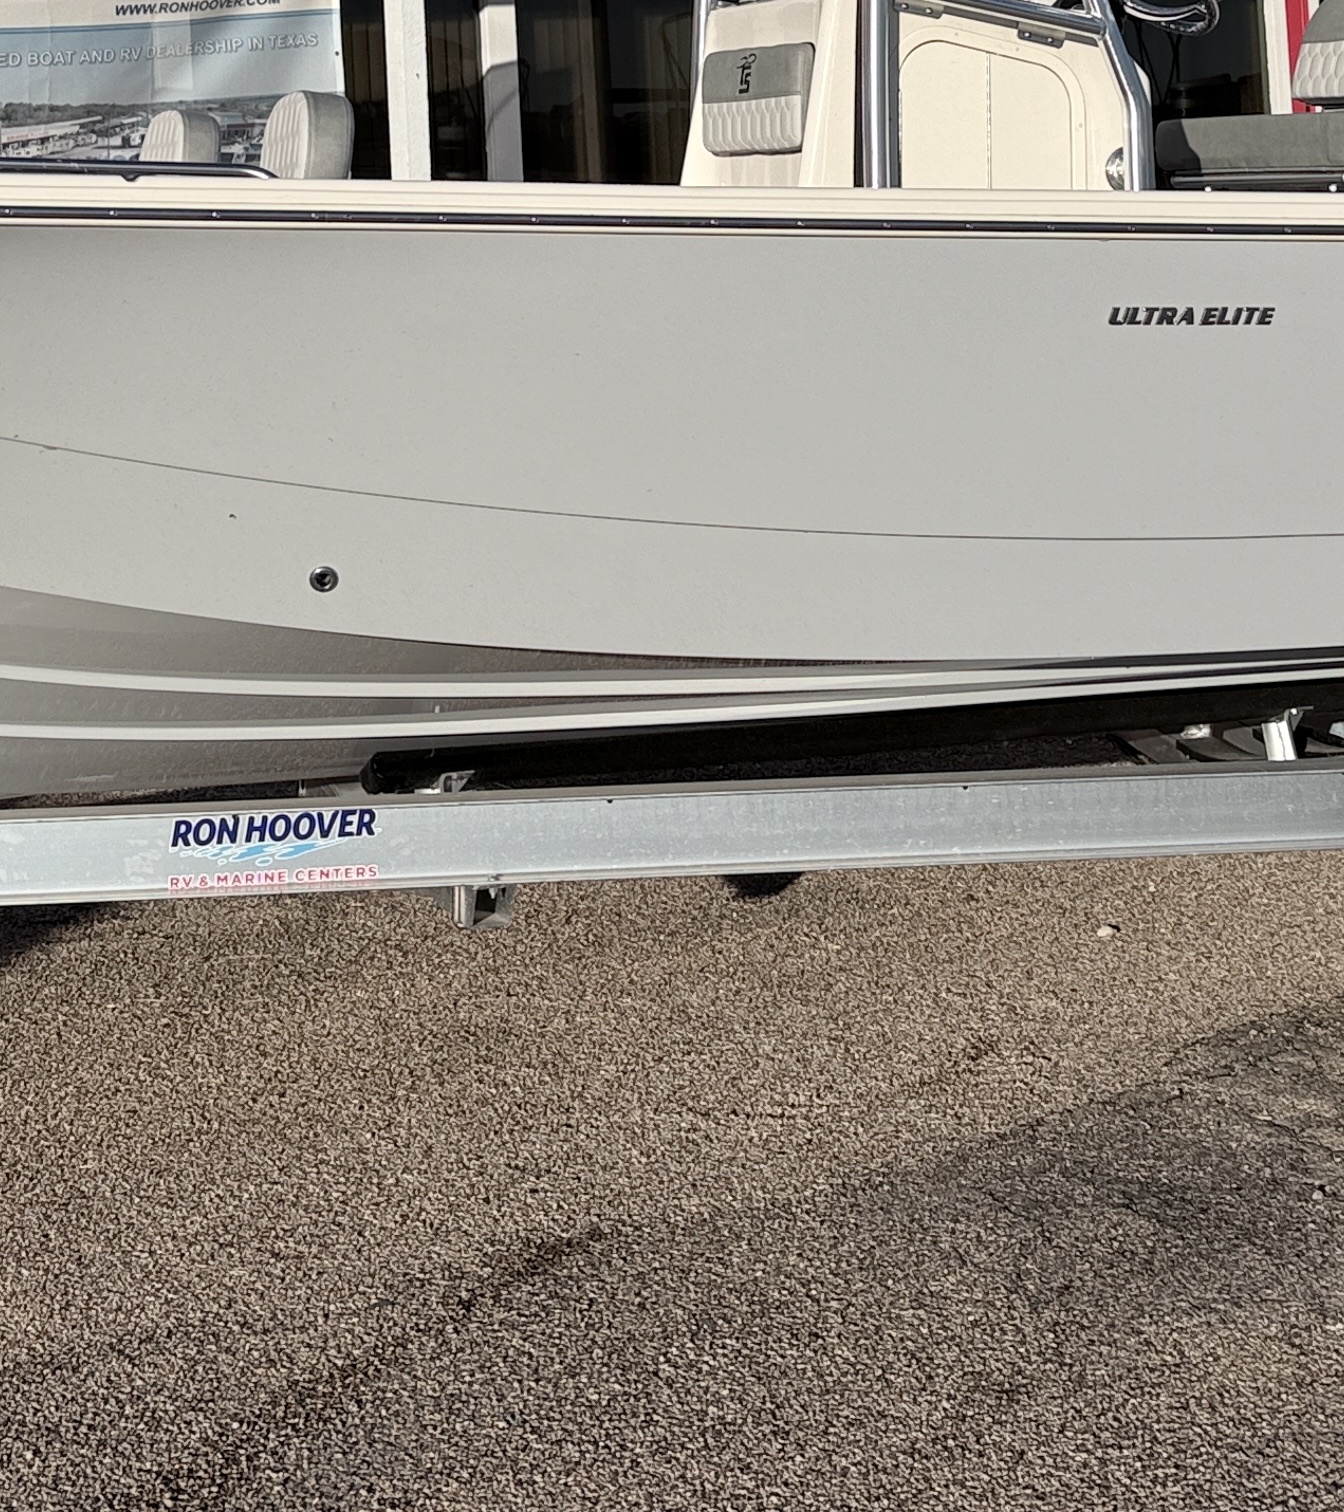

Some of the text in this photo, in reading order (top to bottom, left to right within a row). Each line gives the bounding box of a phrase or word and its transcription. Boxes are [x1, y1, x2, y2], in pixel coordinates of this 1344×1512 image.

[27, 50, 75, 66] BOAT
[79, 48, 115, 65] AND
[120, 46, 140, 62] RV
[146, 37, 244, 59] DEALERSHIP
[248, 36, 265, 51] IN
[268, 32, 318, 48] TEXAS
[1108, 306, 1275, 326] ULTRA ELITE
[171, 808, 377, 848] RON HOOVER
[170, 866, 378, 889] RV & MARINE CENTERS
